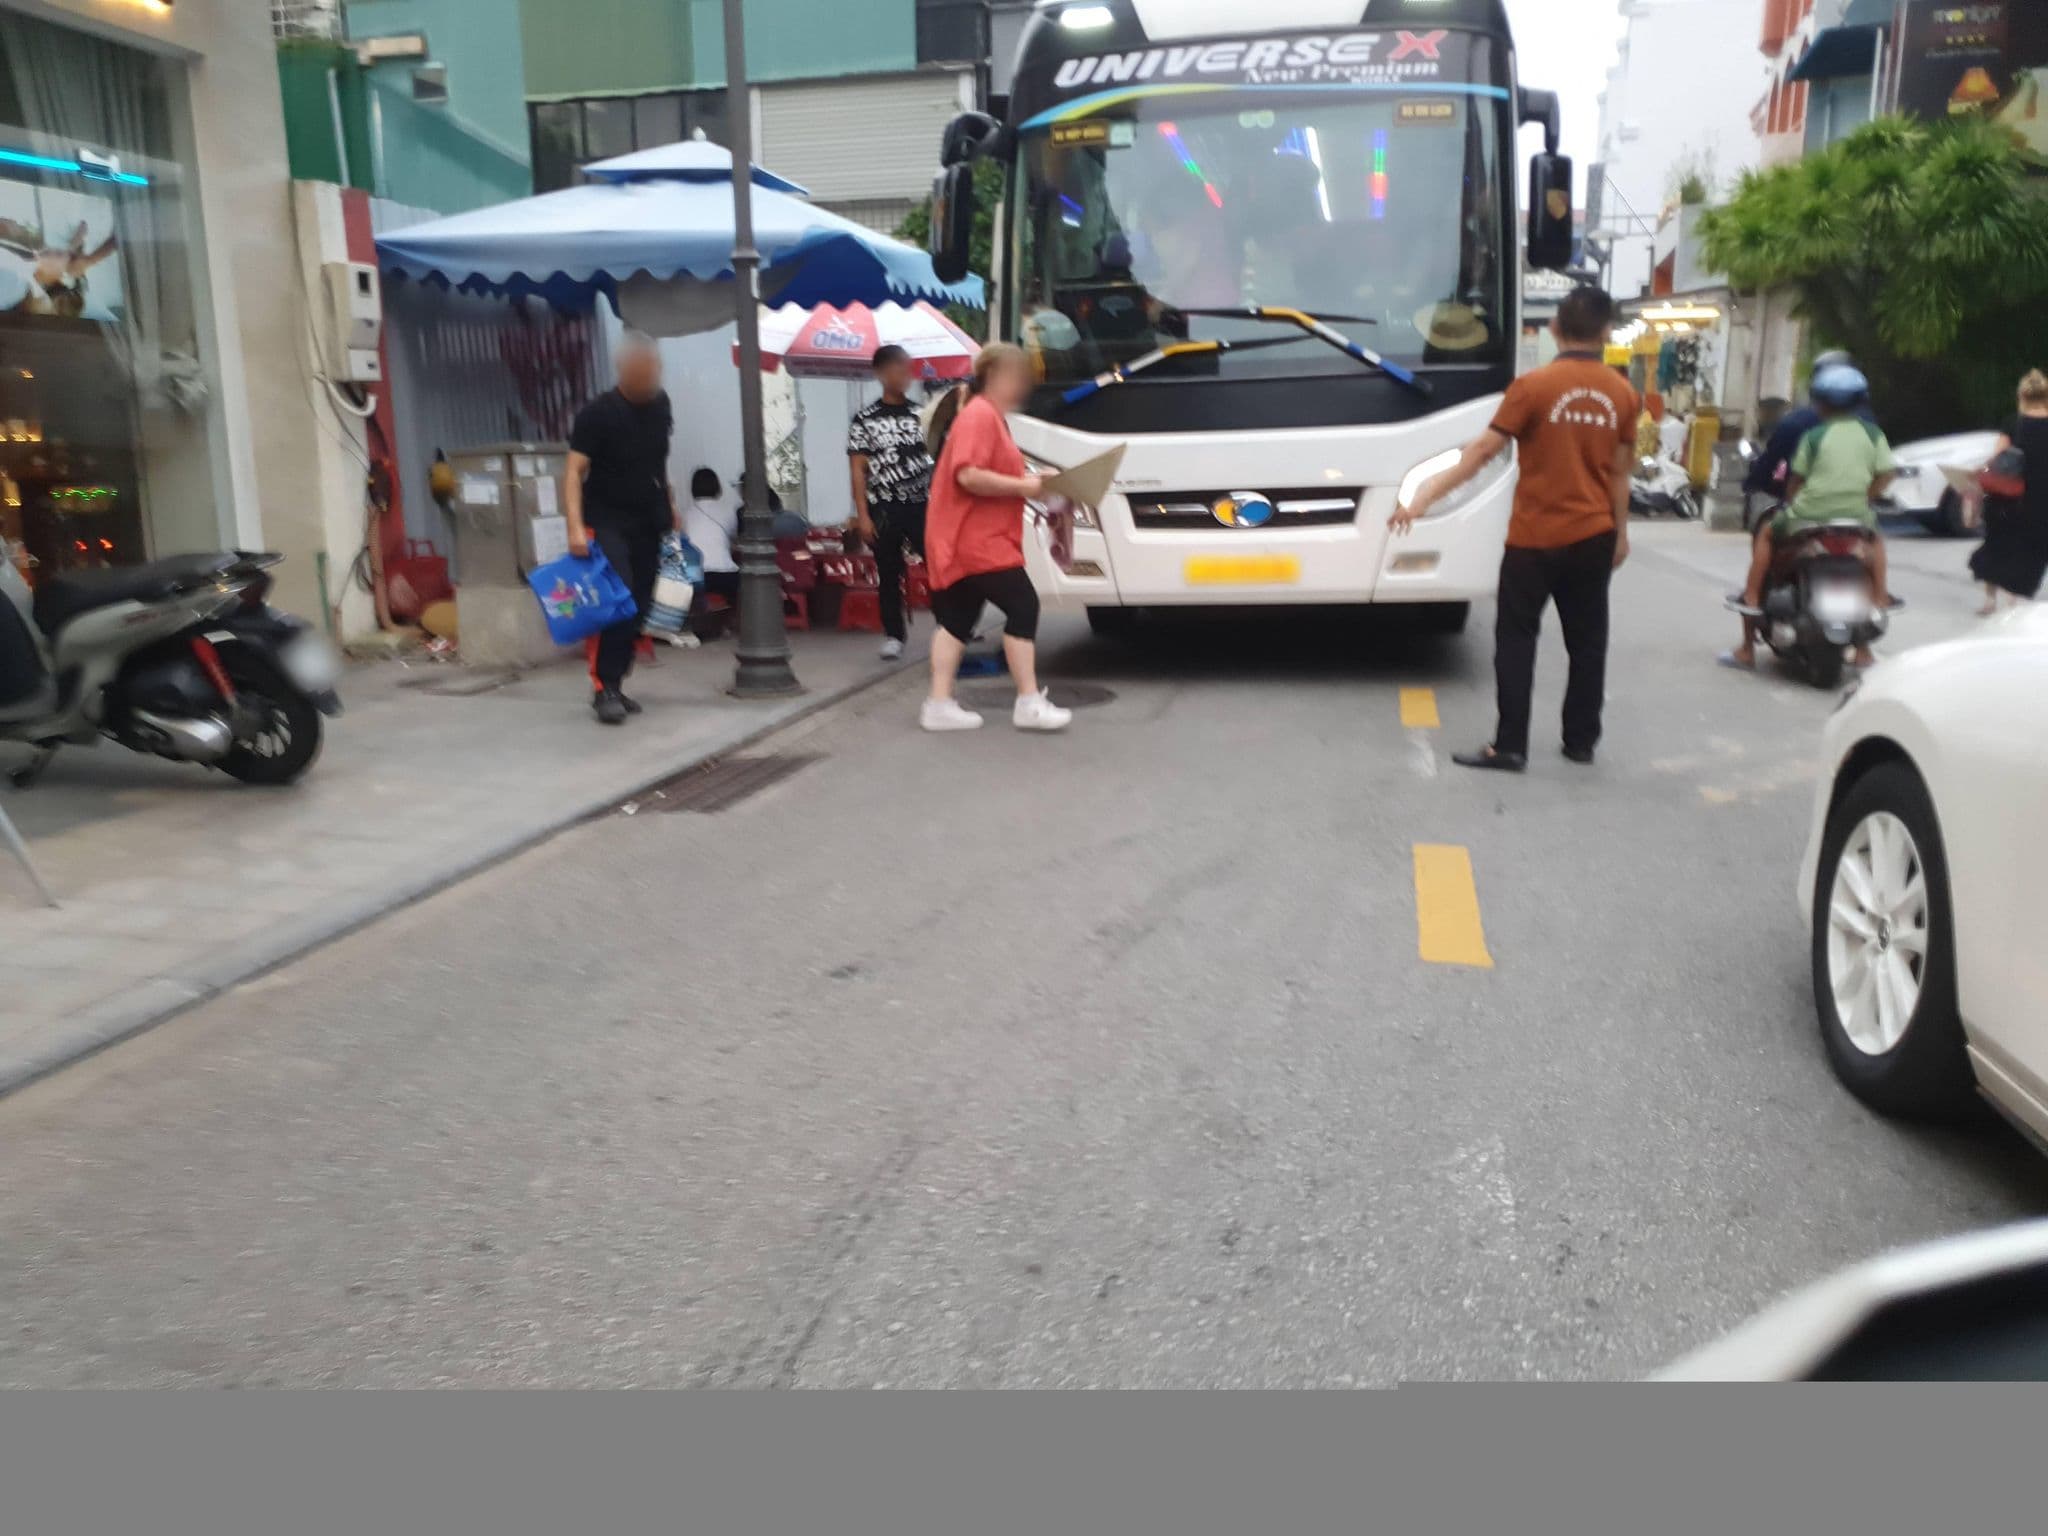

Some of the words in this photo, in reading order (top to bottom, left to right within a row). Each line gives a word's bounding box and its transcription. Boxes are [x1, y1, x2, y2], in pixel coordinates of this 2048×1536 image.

[1054, 33, 1381, 87] UNIVERSE
[1387, 29, 1449, 60] X
[1310, 61, 1440, 80] Premium
[812, 329, 865, 350] OMO
[863, 415, 920, 437] DOLCE
